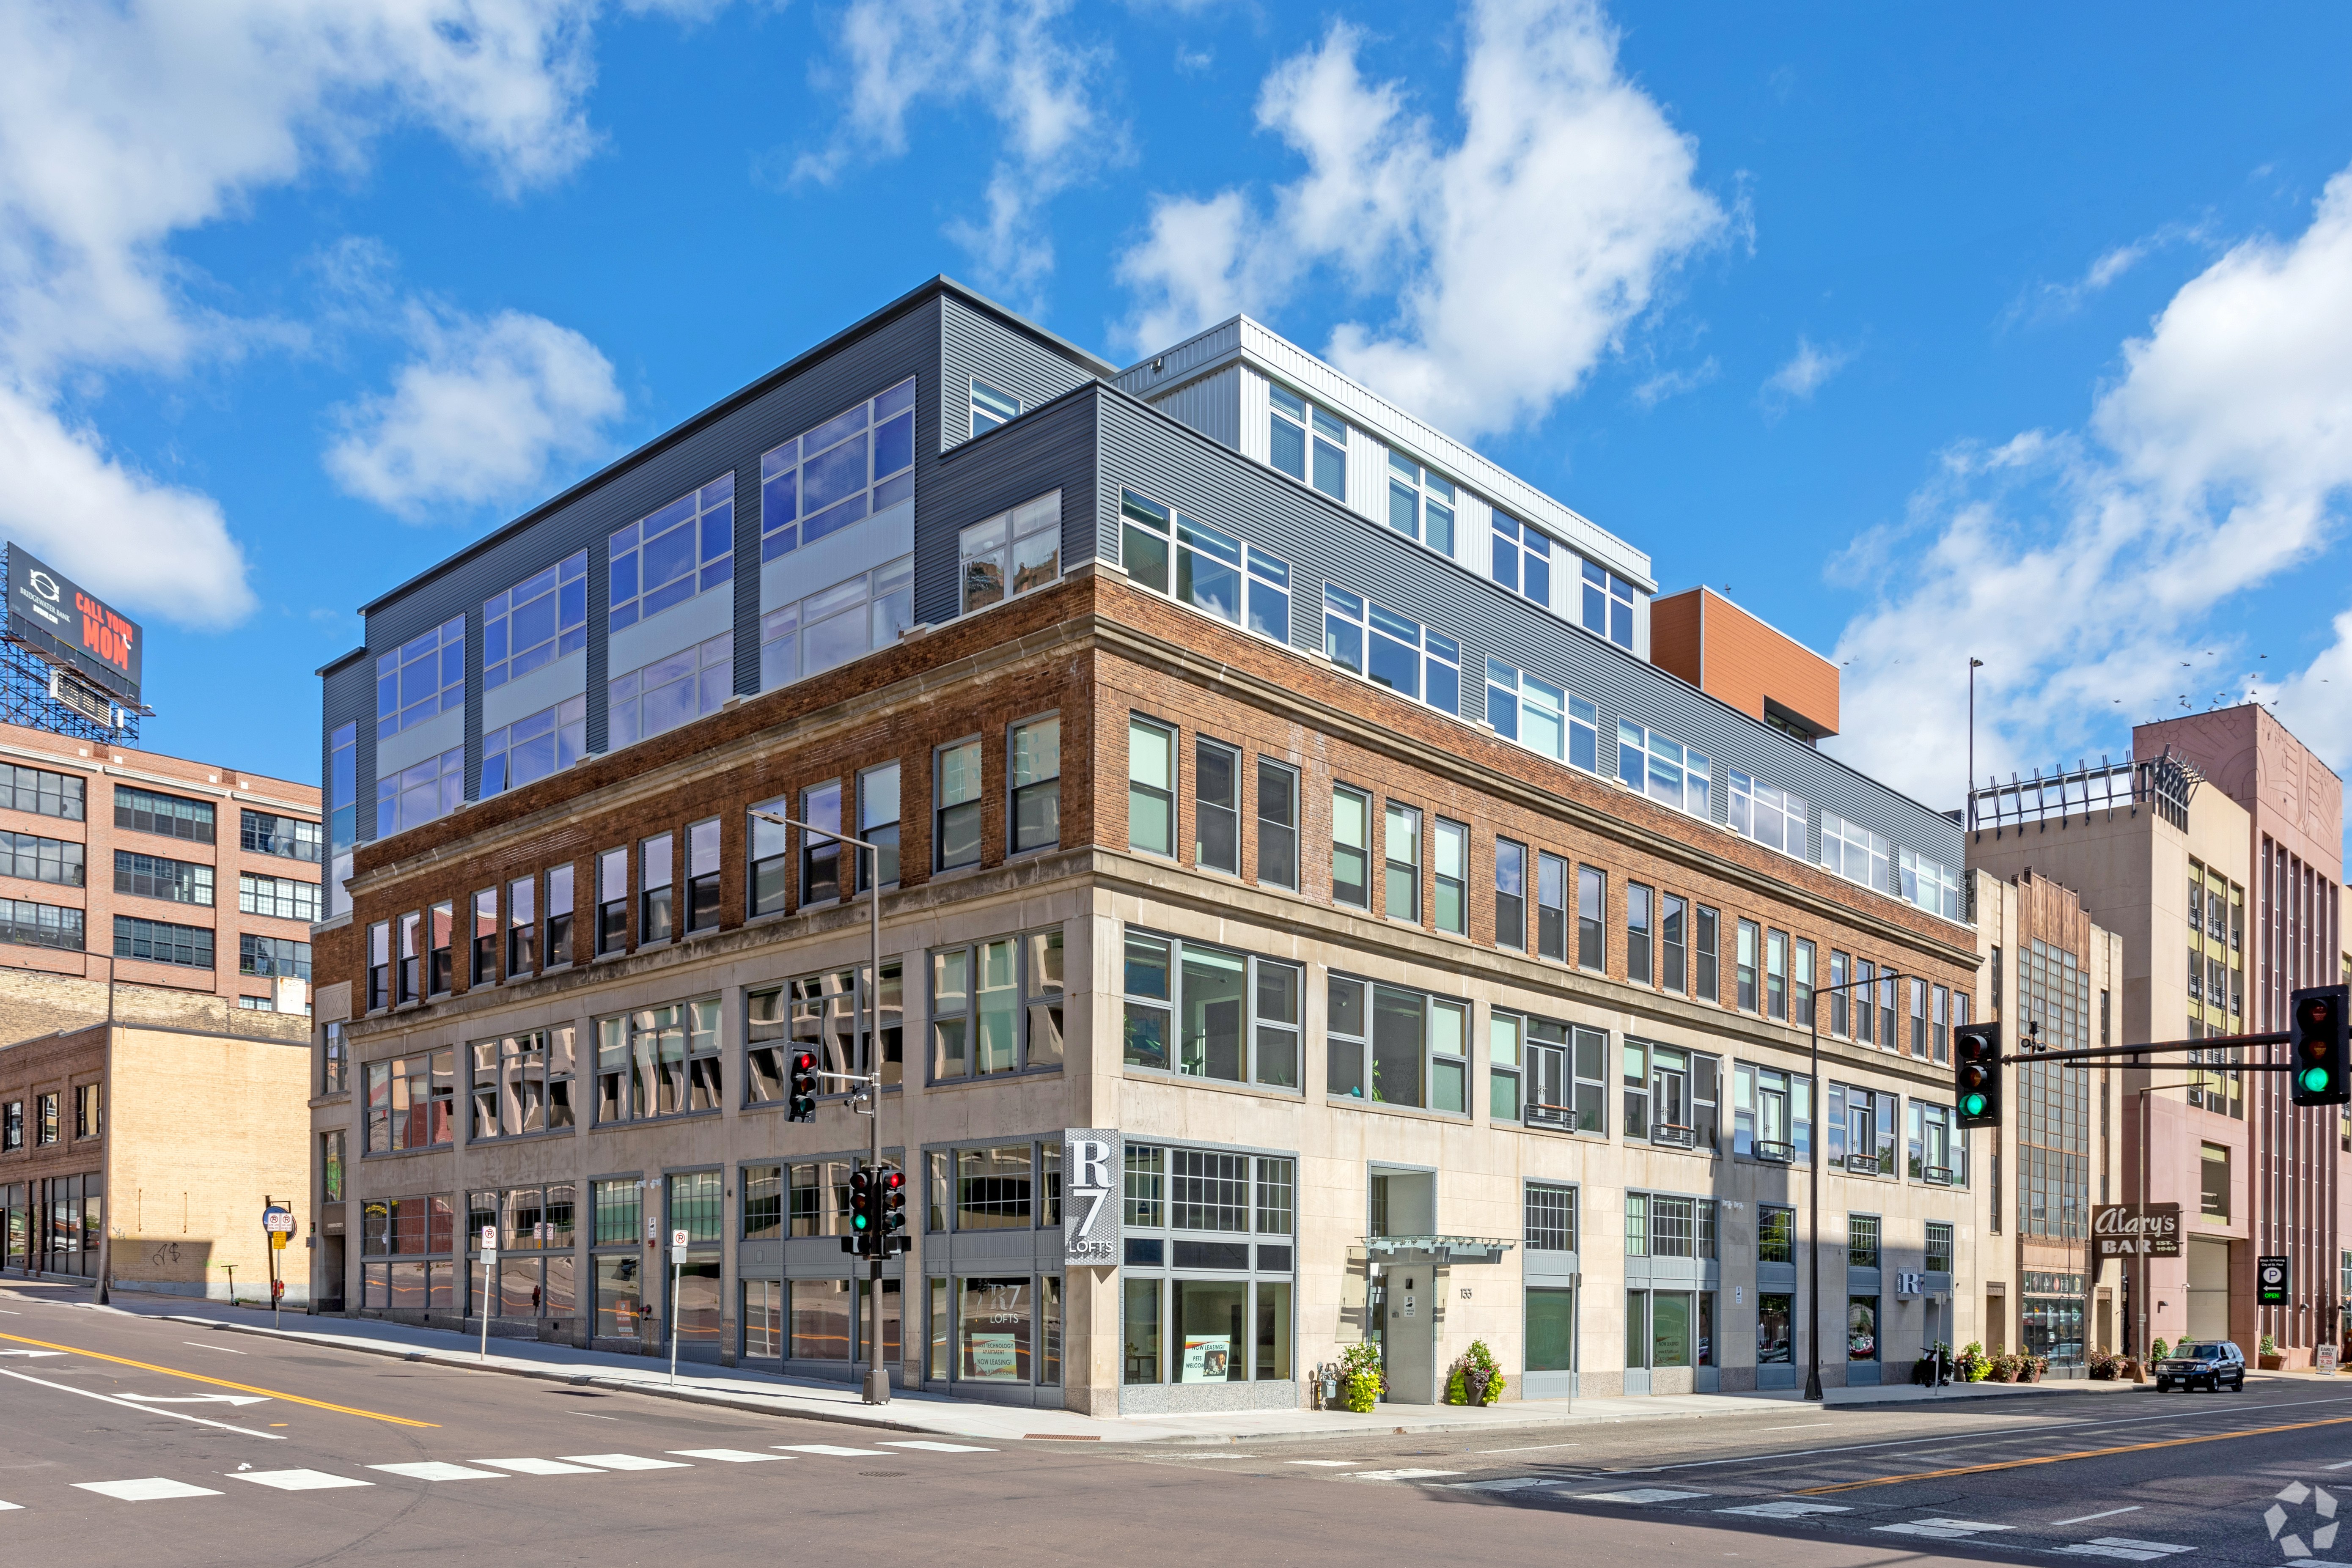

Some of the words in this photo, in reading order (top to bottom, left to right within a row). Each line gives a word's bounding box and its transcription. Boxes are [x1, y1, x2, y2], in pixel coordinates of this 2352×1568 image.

[20, 587, 56, 614] BRIDGEWATER
[57, 609, 71, 623] BANK
[76, 592, 104, 624] CALL
[106, 610, 133, 642] YOUR
[83, 614, 128, 670] MOM
[1068, 1140, 1115, 1188] R
[1073, 1189, 1110, 1236] 7
[1069, 1241, 1113, 1252] LOFTS
[2102, 1240, 2151, 1253] BAR
[2269, 1270, 2278, 1280] P
[989, 1284, 1022, 1310] R7
[1460, 1288, 1473, 1299] 133
[990, 1314, 1019, 1324] LOFTS
